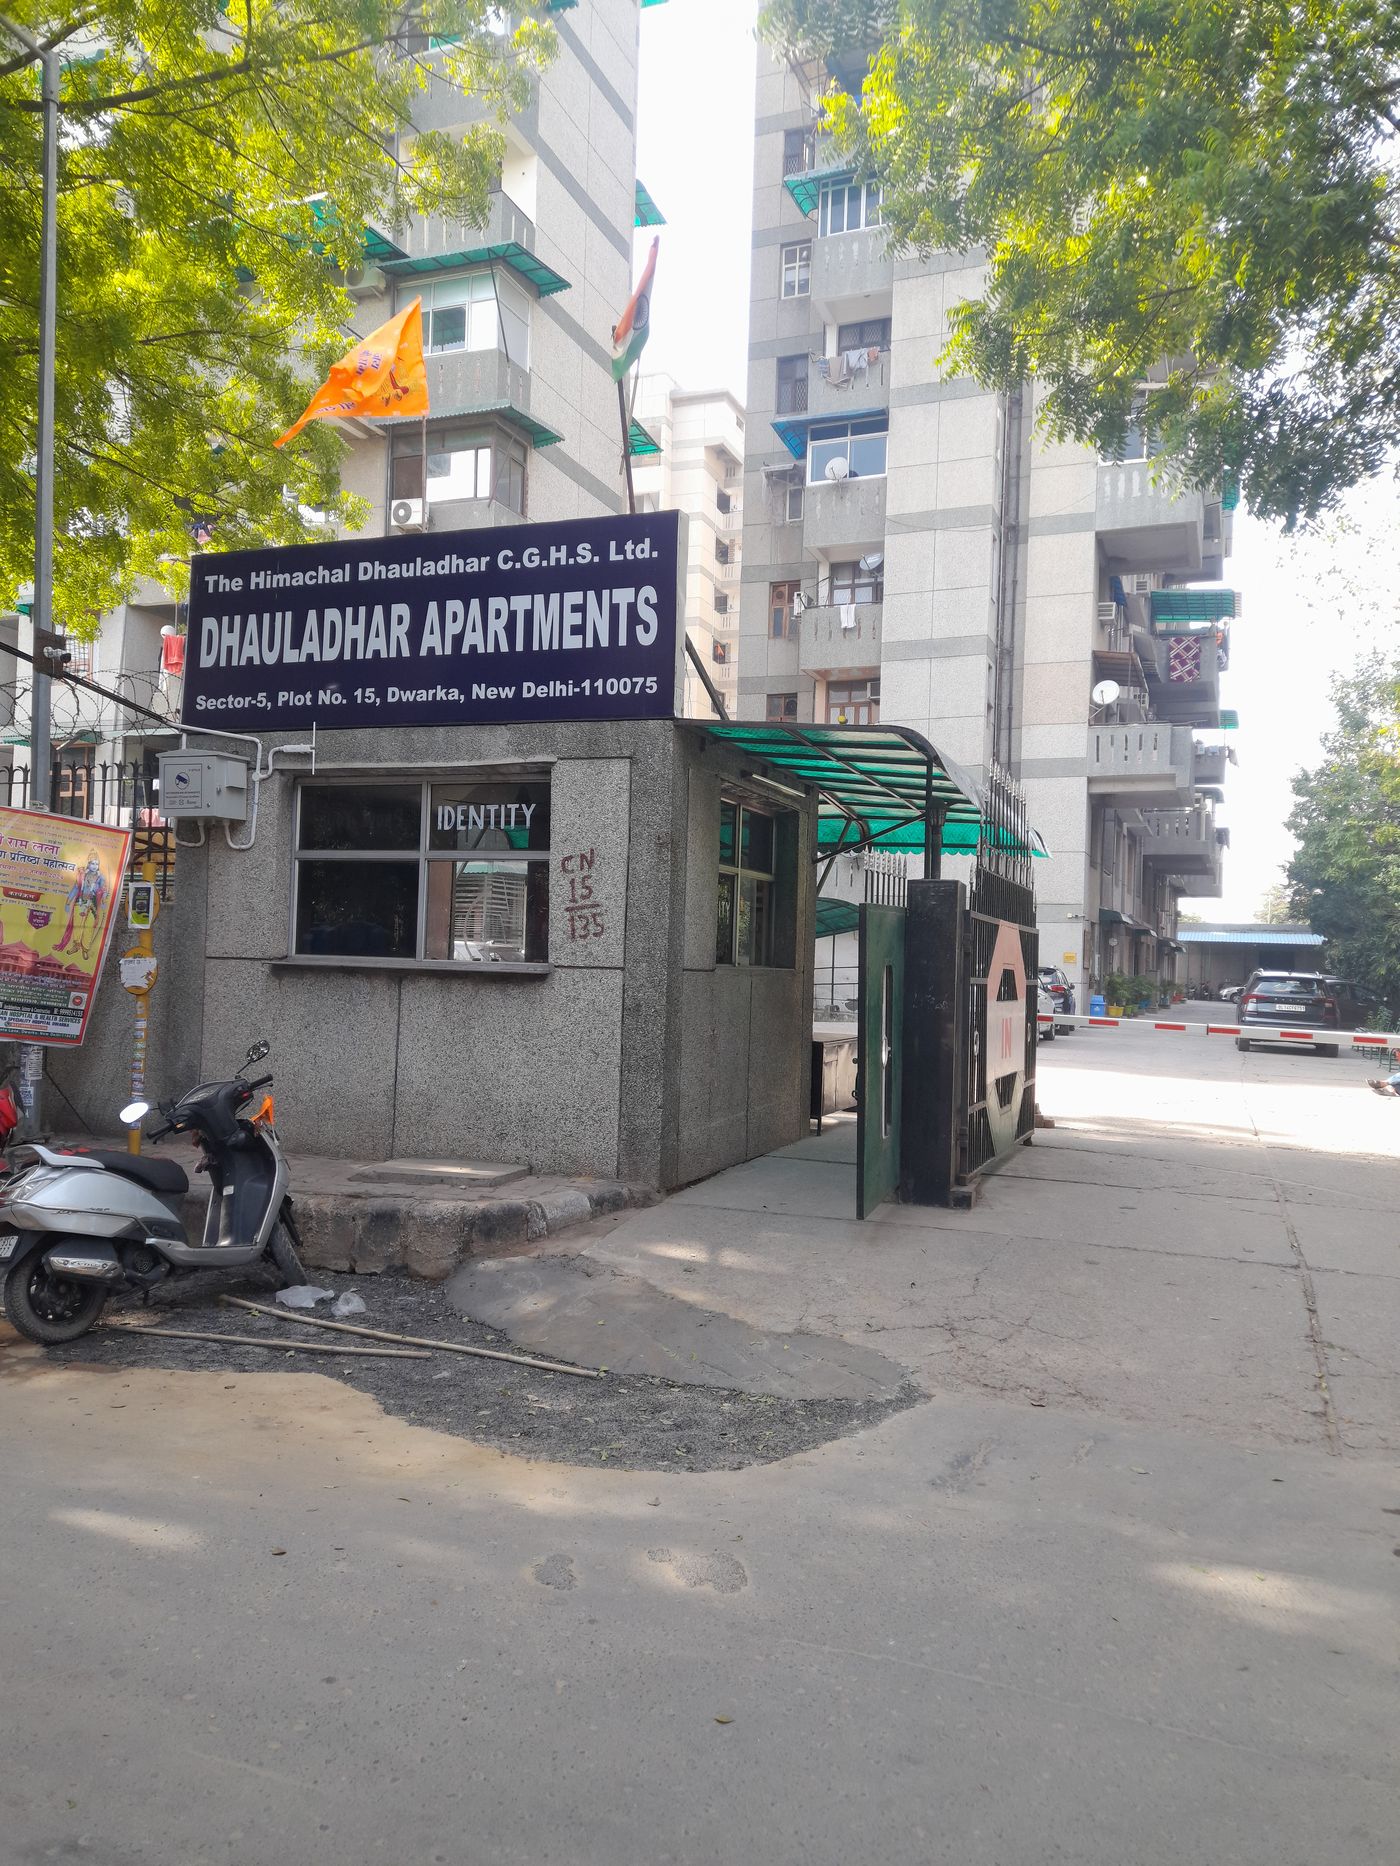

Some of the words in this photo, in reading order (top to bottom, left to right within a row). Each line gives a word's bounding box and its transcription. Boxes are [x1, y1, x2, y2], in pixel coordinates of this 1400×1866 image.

[205, 575, 243, 593] The
[250, 564, 350, 590] Himachal
[358, 554, 490, 581] Dhauladhar
[497, 542, 600, 570] C.G.H.S.
[609, 537, 658, 561] Ltd.
[199, 603, 411, 668] DHAULADHAR
[419, 585, 658, 657] APARTMENTS
[195, 692, 272, 710] Sector-5,
[277, 690, 313, 707] Plot
[318, 689, 347, 705] No.
[353, 687, 381, 706] 15,
[387, 685, 465, 704] Dwarka,
[471, 683, 516, 700] New
[522, 676, 658, 698] Delhi-110075
[437, 803, 537, 831] IDENTITY
[569, 875, 594, 903] 15
[1001, 1016, 1012, 1059] IN
